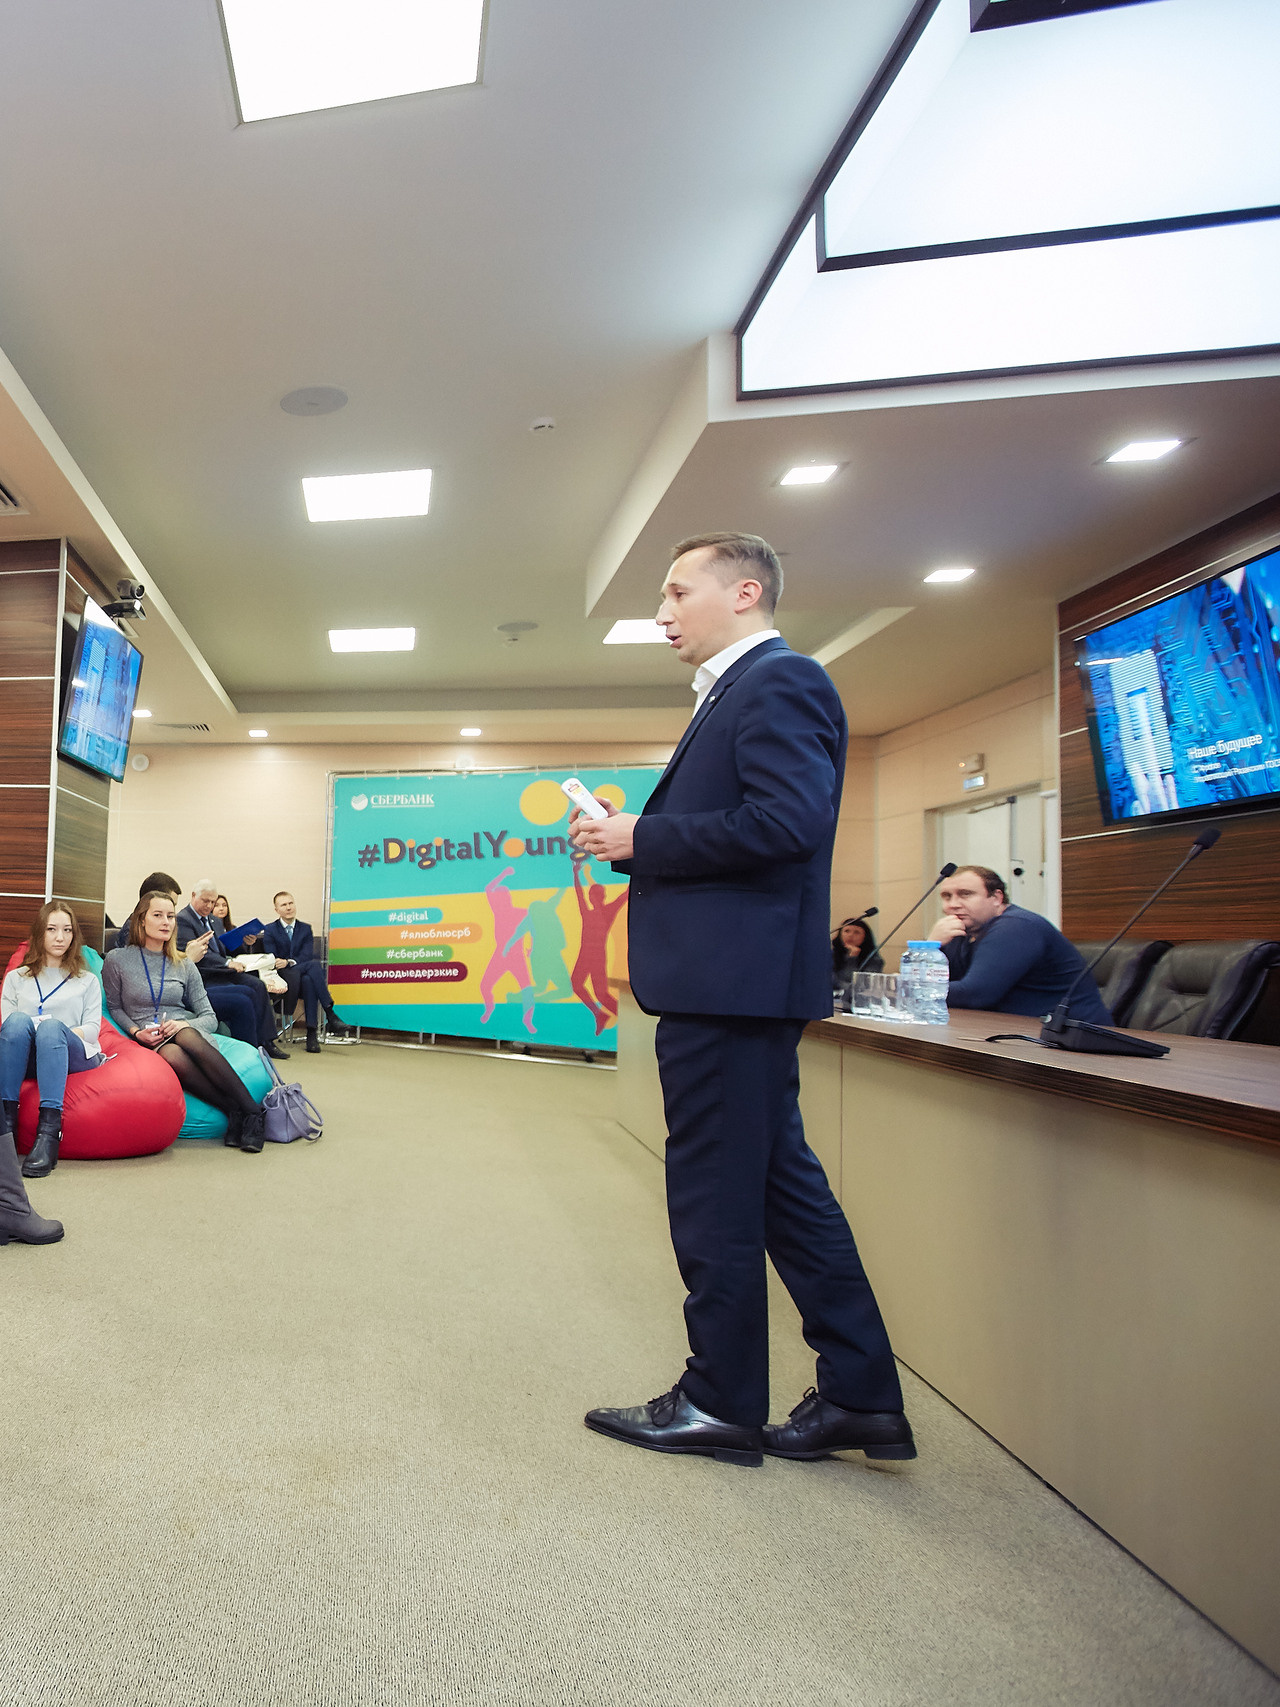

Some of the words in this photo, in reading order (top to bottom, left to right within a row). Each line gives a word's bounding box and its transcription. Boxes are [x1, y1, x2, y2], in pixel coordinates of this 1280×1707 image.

[1216, 734, 1263, 755] будущее
[370, 794, 435, 805] СБЕРБАНК
[388, 911, 429, 923] #digital
[400, 927, 471, 940] #ялюблюсрб
[386, 948, 444, 960] #сбербанк
[361, 968, 459, 980] #молодыедерзкие
